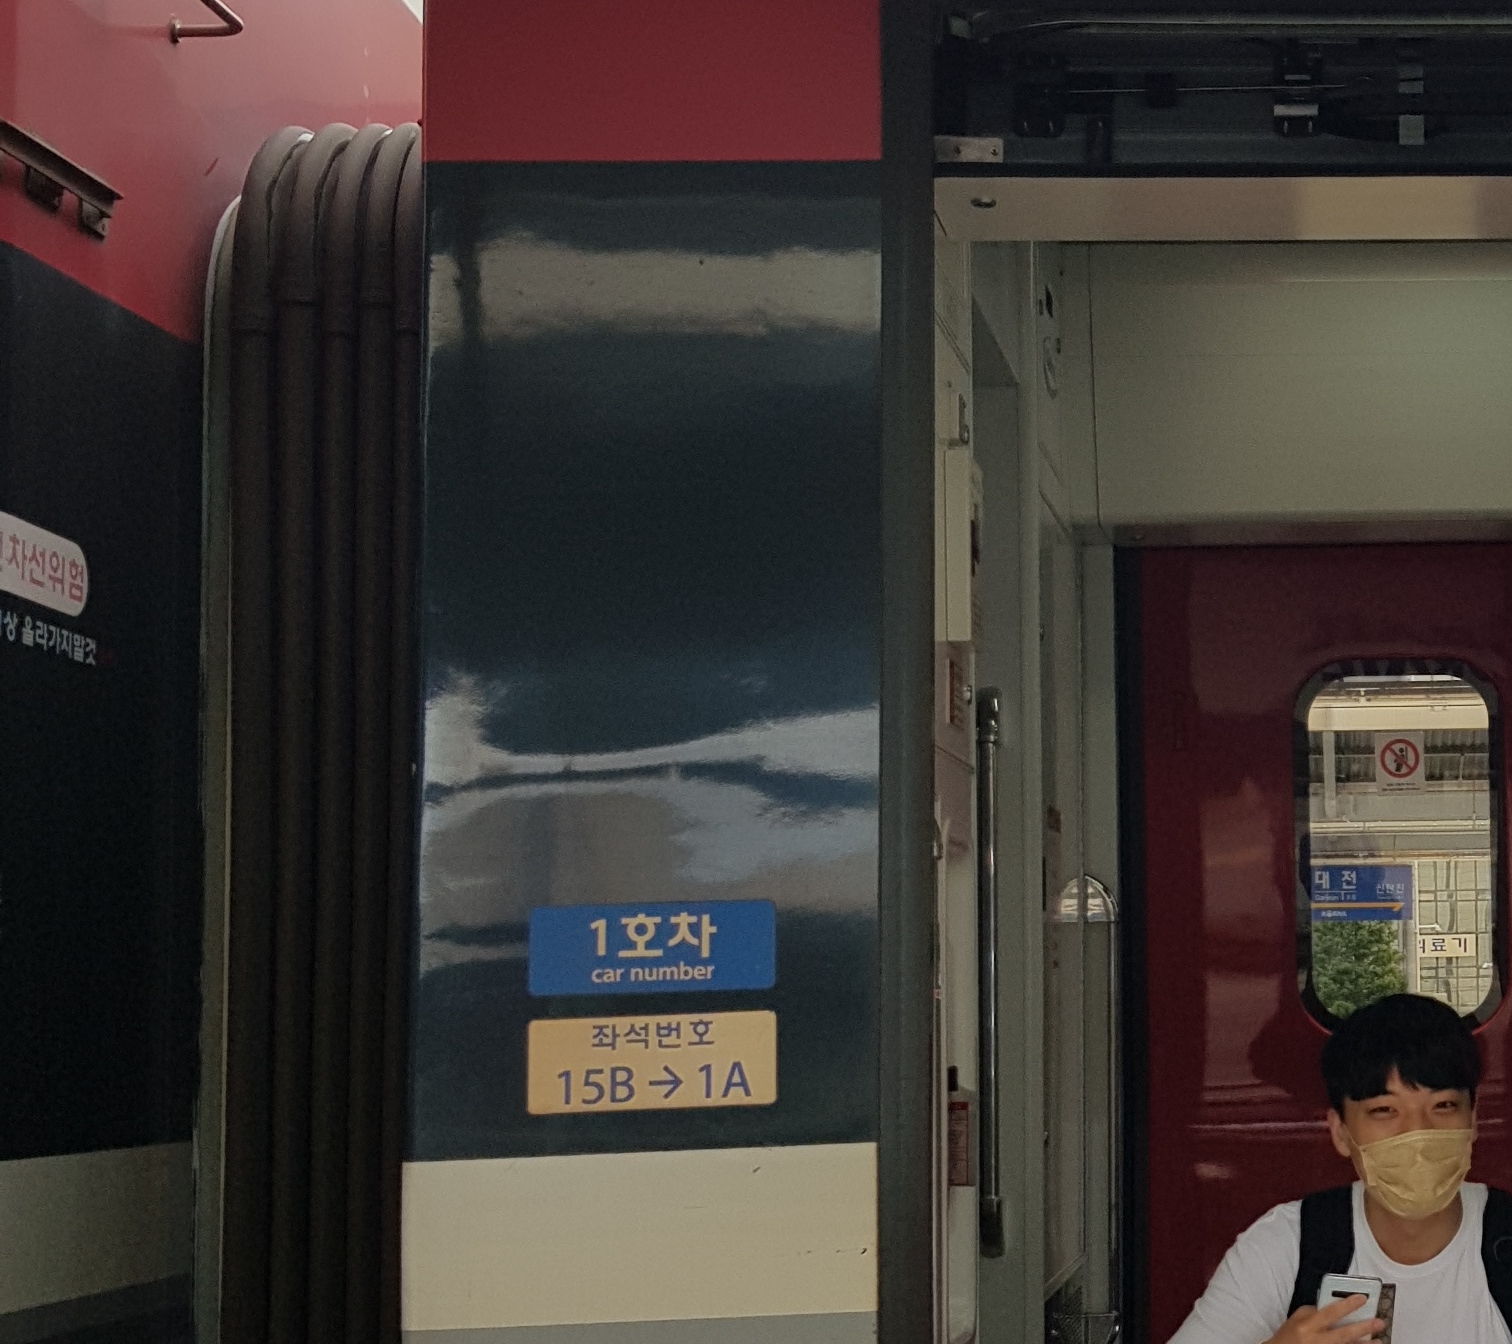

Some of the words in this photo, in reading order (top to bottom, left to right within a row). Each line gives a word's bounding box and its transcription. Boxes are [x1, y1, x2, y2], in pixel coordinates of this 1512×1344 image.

[589, 912, 718, 959] 1호차
[590, 965, 625, 984] car
[629, 960, 715, 982] number
[590, 1018, 716, 1051] 좌석번호
[556, 1066, 636, 1106] 15B
[697, 1060, 752, 1100] 1A
